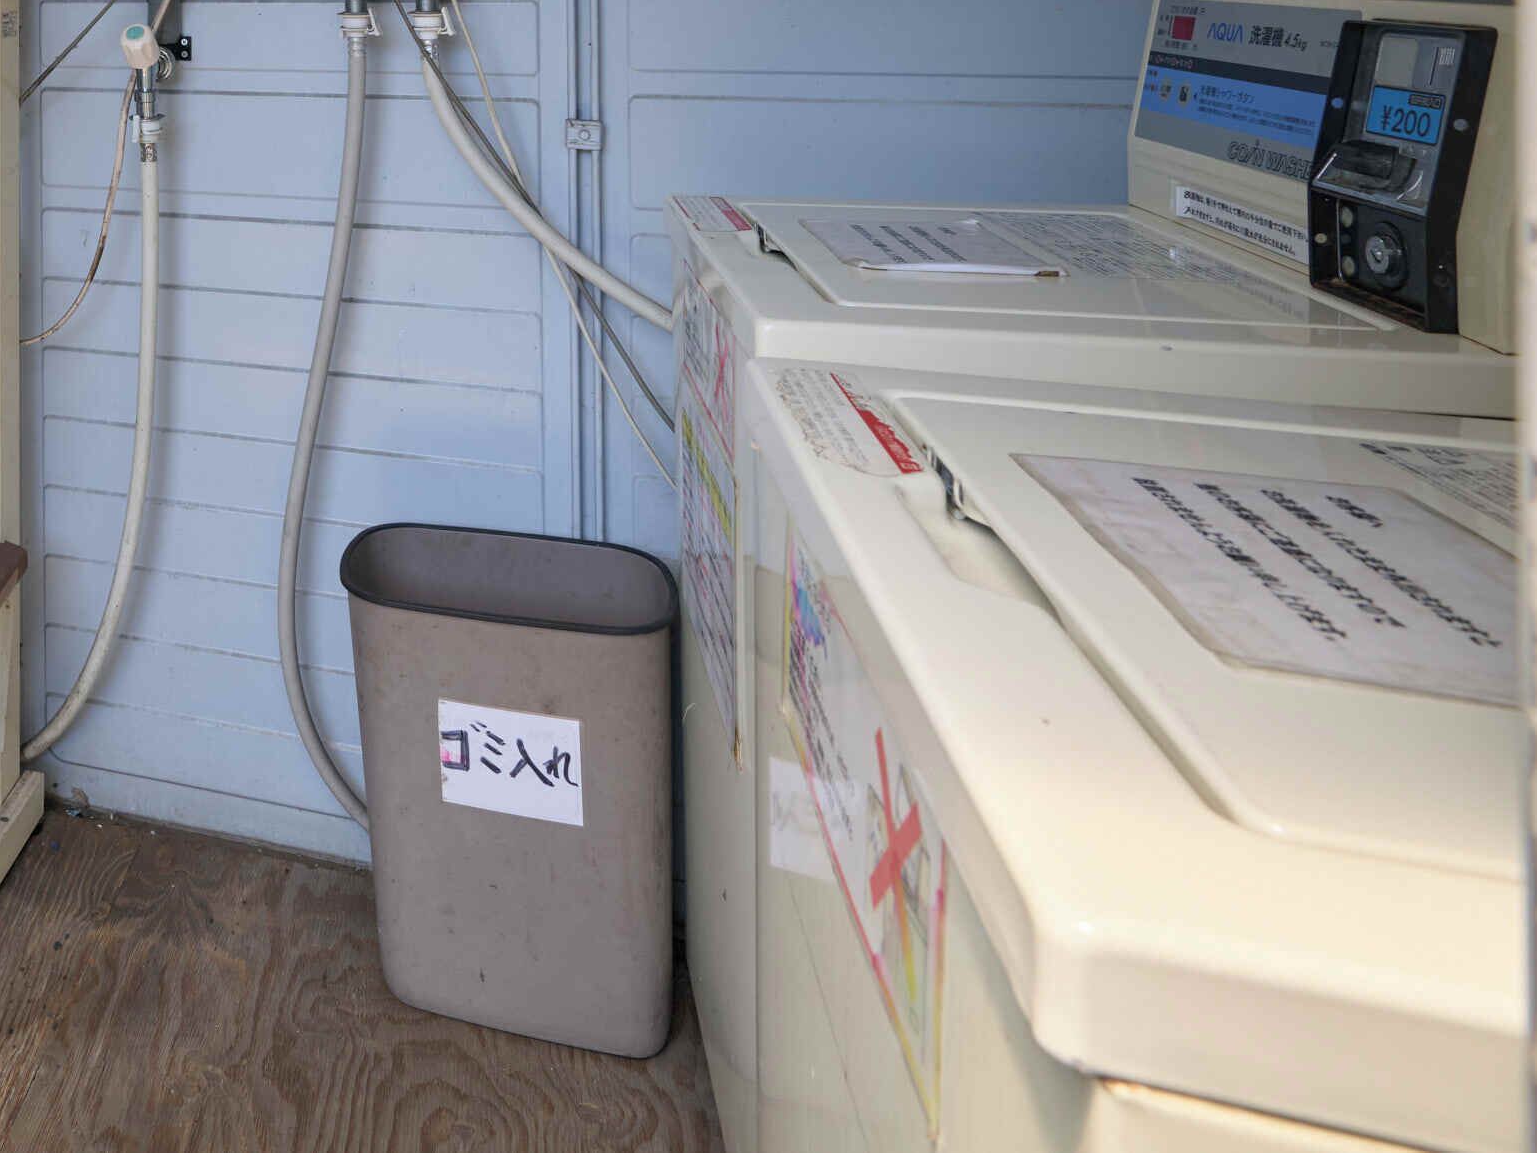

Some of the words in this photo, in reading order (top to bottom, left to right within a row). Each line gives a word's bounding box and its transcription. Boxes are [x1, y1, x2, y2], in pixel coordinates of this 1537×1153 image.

[1248, 25, 1284, 48] 洗濯機
[1382, 105, 1431, 137] ¥200
[440, 719, 580, 788] ゴミ入れ
